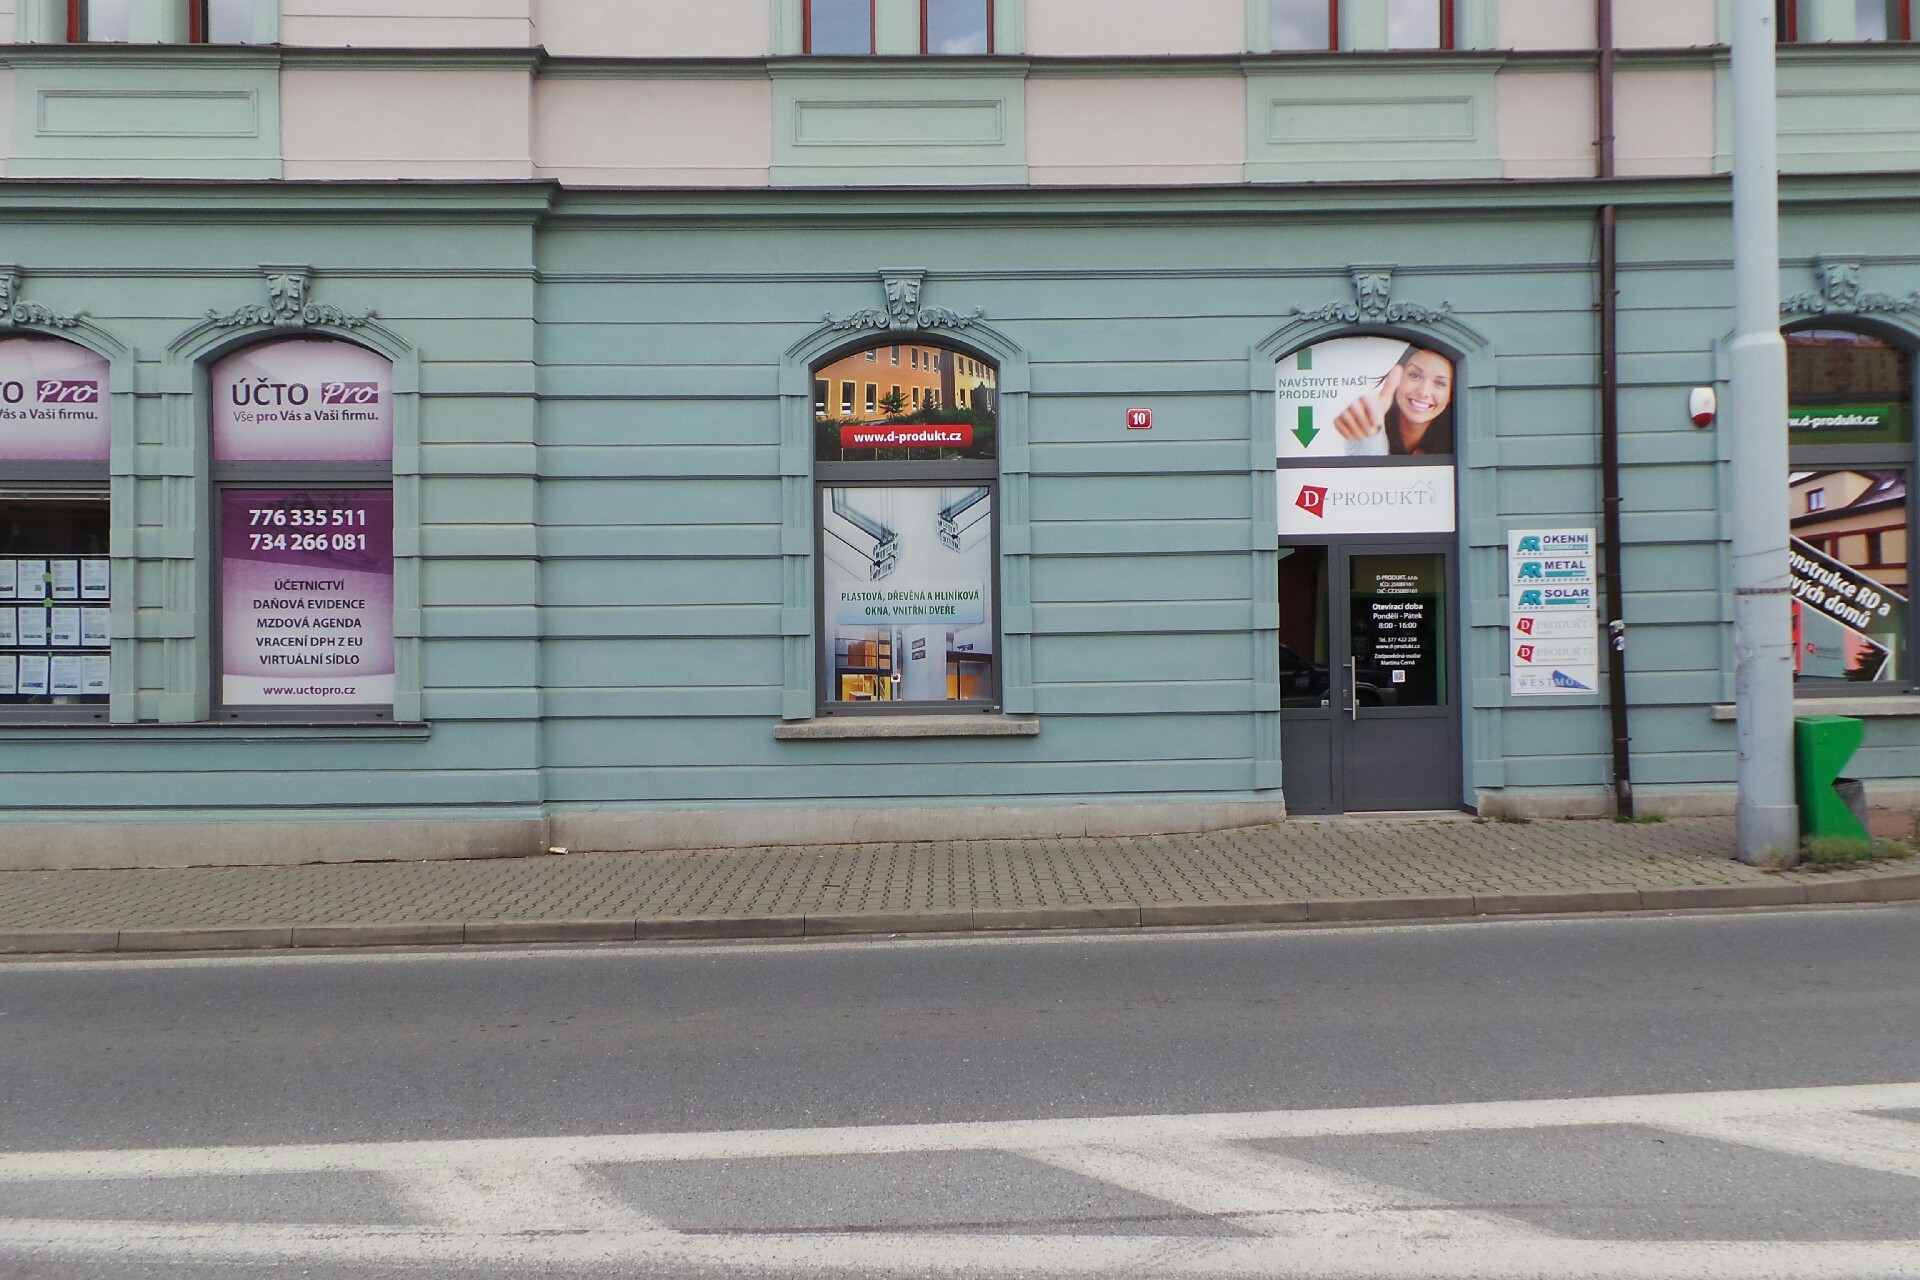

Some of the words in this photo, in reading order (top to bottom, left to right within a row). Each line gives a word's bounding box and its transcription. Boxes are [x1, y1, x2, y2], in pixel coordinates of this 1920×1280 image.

[1278, 376, 1339, 388] NAVŠTIVTE
[1341, 374, 1367, 386] NAŠÍ
[0, 381, 24, 403] O
[38, 380, 99, 402] Pro
[232, 377, 309, 406] ÚČTO
[322, 382, 378, 404] Pro
[1279, 389, 1338, 400] PRODEJNU
[19, 411, 27, 420] a
[28, 408, 56, 420] Vaši
[58, 408, 98, 420] firmu.
[233, 411, 254, 422] Vše
[256, 413, 278, 424] pro
[280, 410, 302, 421] Vás
[304, 413, 312, 421] a
[314, 410, 339, 421] Vaši
[341, 409, 379, 421] firmu.
[1133, 412, 1146, 425] 10
[853, 430, 962, 444] www.d-produkt.cz
[1303, 490, 1427, 507] D-PRODUKT
[249, 509, 287, 526] 776
[290, 509, 328, 526] 335
[331, 509, 366, 526] 511
[249, 534, 287, 551] 734
[290, 534, 329, 551] 266
[331, 534, 366, 551] 081
[1543, 533, 1589, 544] OKENNÍ
[1544, 560, 1586, 570] METAL
[274, 578, 345, 591] ÚČETNICTVÍ
[841, 590, 885, 602] PLASTOVÁ,
[887, 590, 926, 601] DŘEVĚNÁ
[927, 591, 933, 600] A
[934, 590, 980, 600] HLINÍKOVÁ
[1544, 588, 1590, 598] SOLAR
[253, 597, 305, 610] DAŇOVÁ
[307, 599, 366, 610] EVIDENCE
[1787, 574, 1826, 604] vých
[1824, 594, 1871, 628] domů
[1855, 586, 1881, 609] RD
[1877, 602, 1891, 617] a
[865, 606, 891, 616] OKNA,
[892, 604, 927, 615] VNITŘNÍ
[929, 603, 955, 615] DVEŘE
[256, 616, 310, 628] MZDOVÁ
[312, 618, 362, 628] AGENDA
[255, 635, 308, 647] VRACENÍ
[310, 637, 335, 647] DPH
[337, 637, 346, 647] Z
[347, 637, 363, 647] EU
[259, 653, 323, 665] VIRTUÁLNÍ
[325, 653, 360, 665] SÍDLO
[263, 686, 356, 697] www.uctopro.cz
